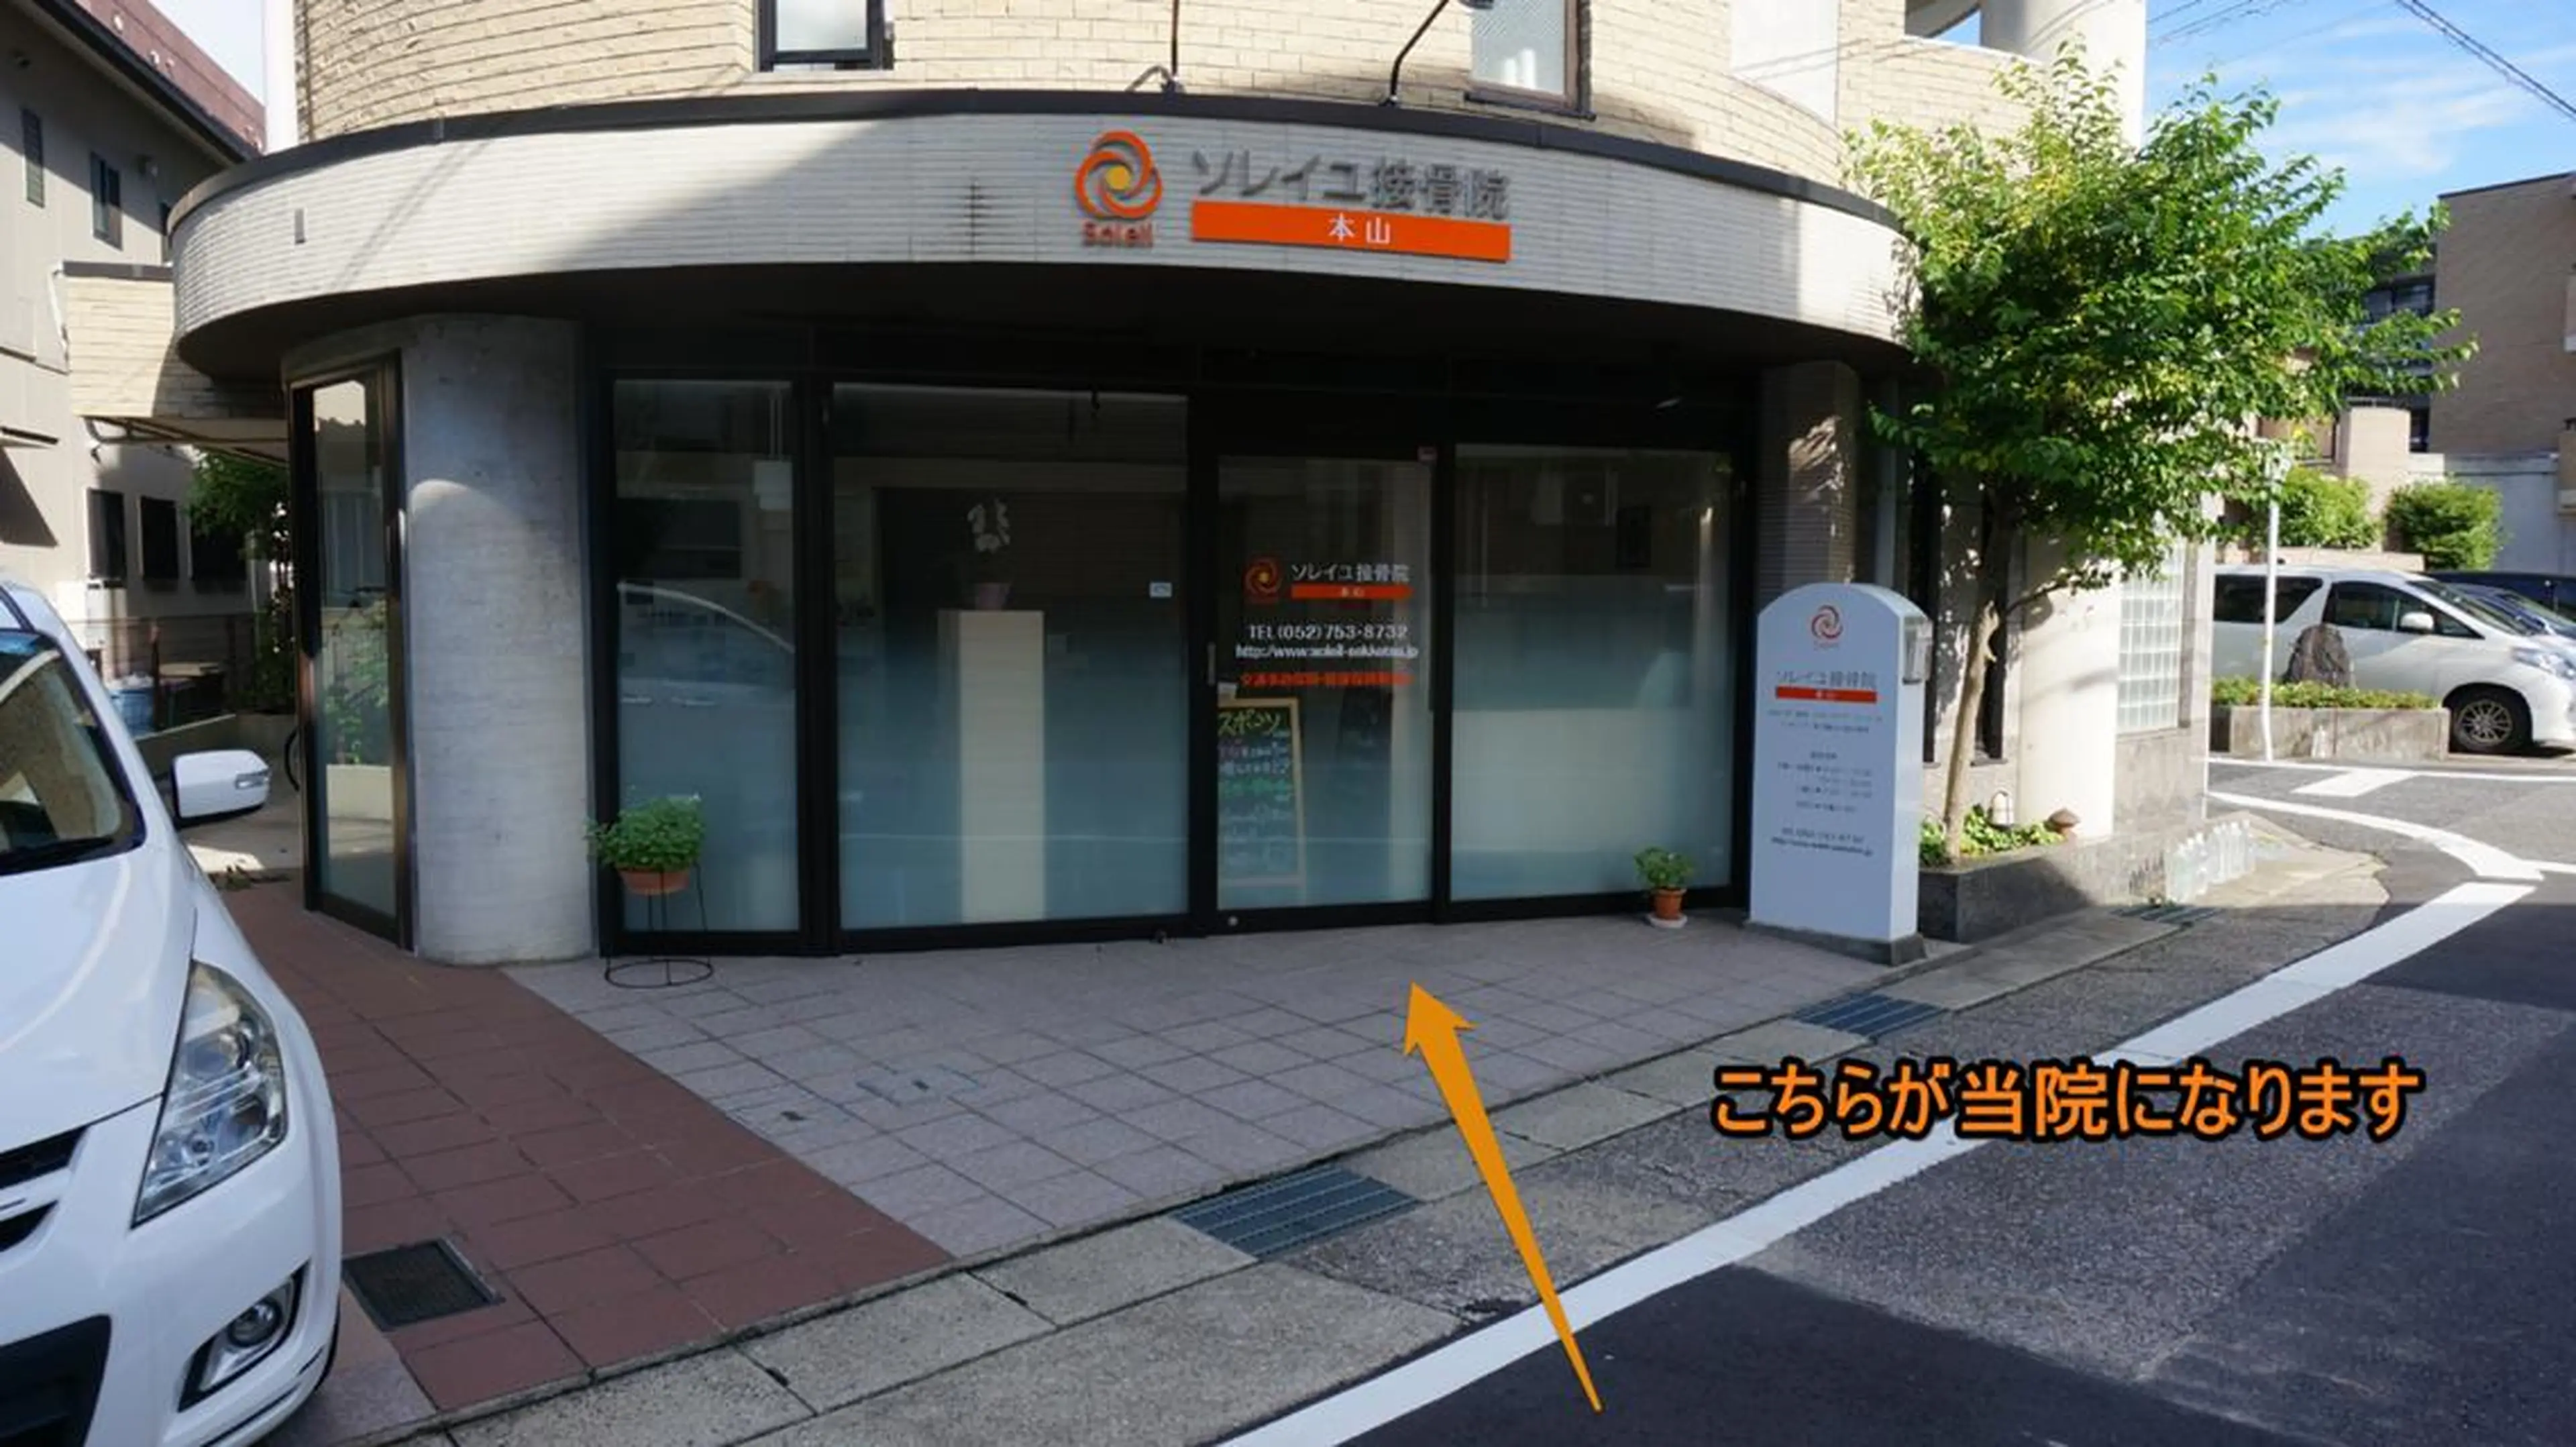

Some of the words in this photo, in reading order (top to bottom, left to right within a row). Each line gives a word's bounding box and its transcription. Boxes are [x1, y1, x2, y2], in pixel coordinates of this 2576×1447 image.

[1193, 149, 1509, 221] ソレイユ接骨院
[1328, 212, 1391, 246] 本山
